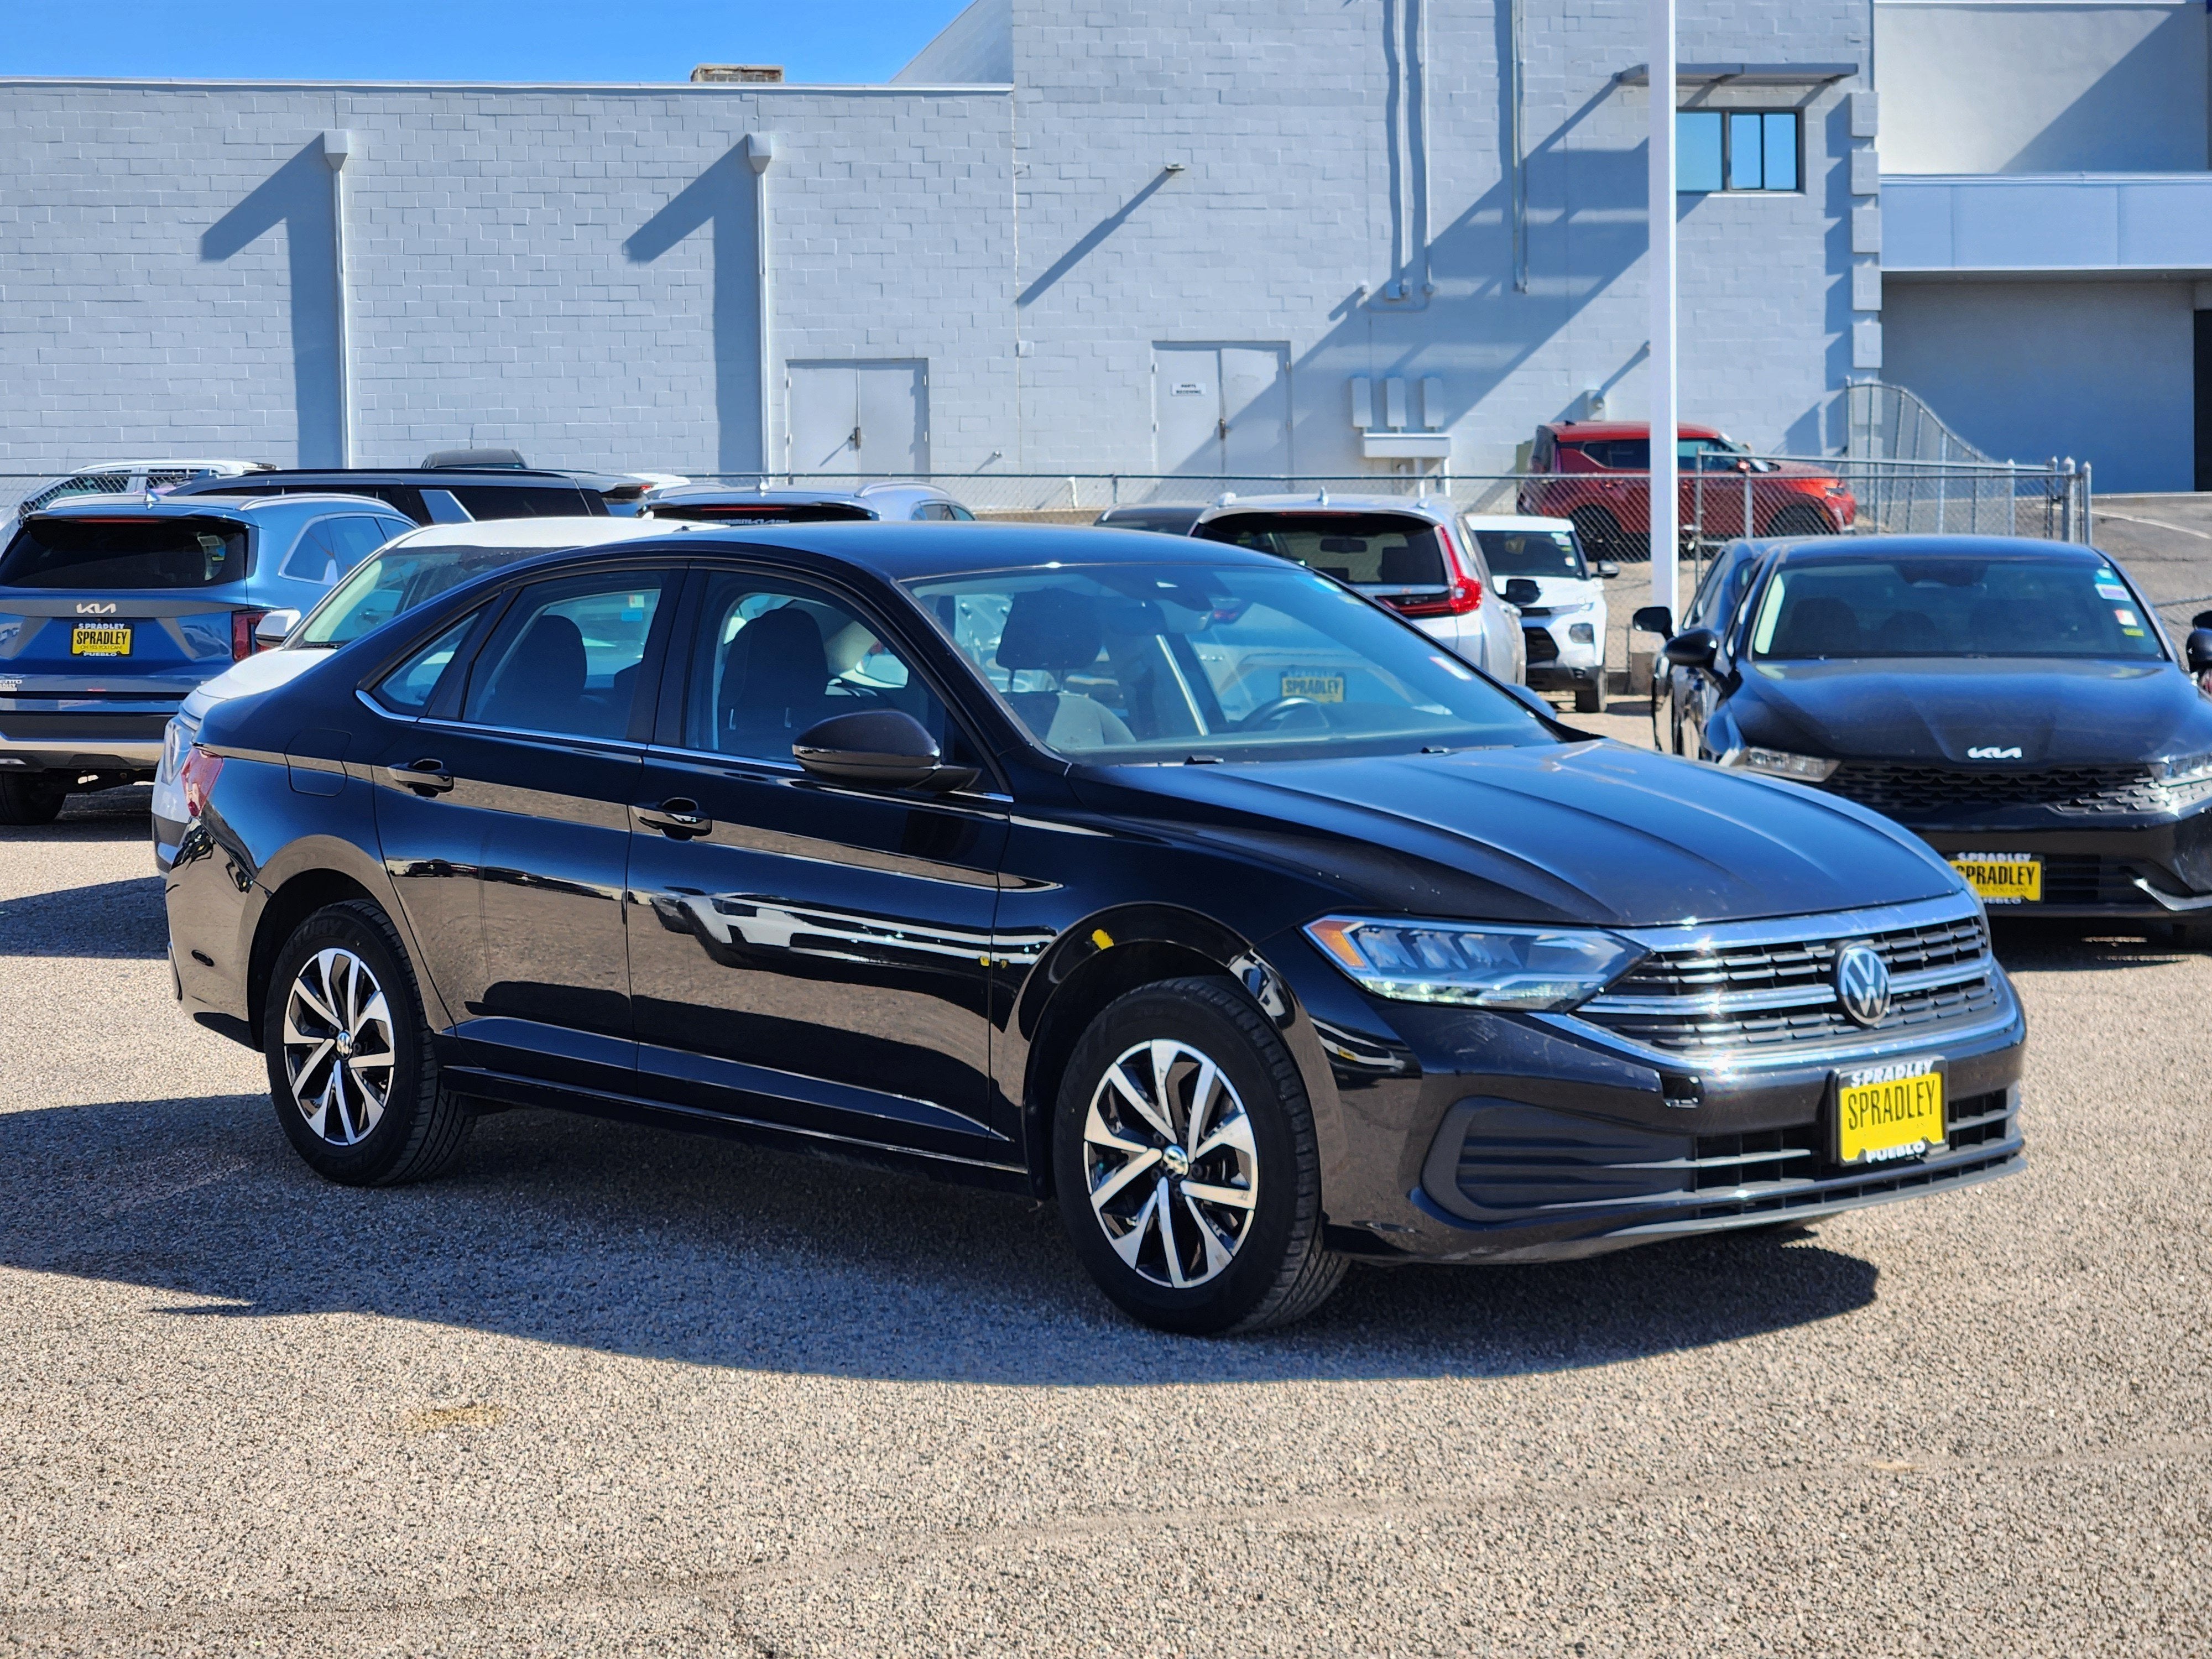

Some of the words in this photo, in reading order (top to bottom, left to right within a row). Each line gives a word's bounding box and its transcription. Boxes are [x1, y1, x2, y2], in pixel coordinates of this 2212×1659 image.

[76, 603, 117, 614] KIA
[76, 631, 127, 645] SPRADLEY
[1286, 680, 1339, 694] SPRADLEY
[1967, 747, 2022, 759] KIA
[1957, 852, 2032, 863] SPRADLEY
[1850, 1060, 1934, 1088] SPRADLEY
[1848, 1079, 1935, 1131] SPRADLEY
[1866, 1140, 1926, 1164] PUEBLO
